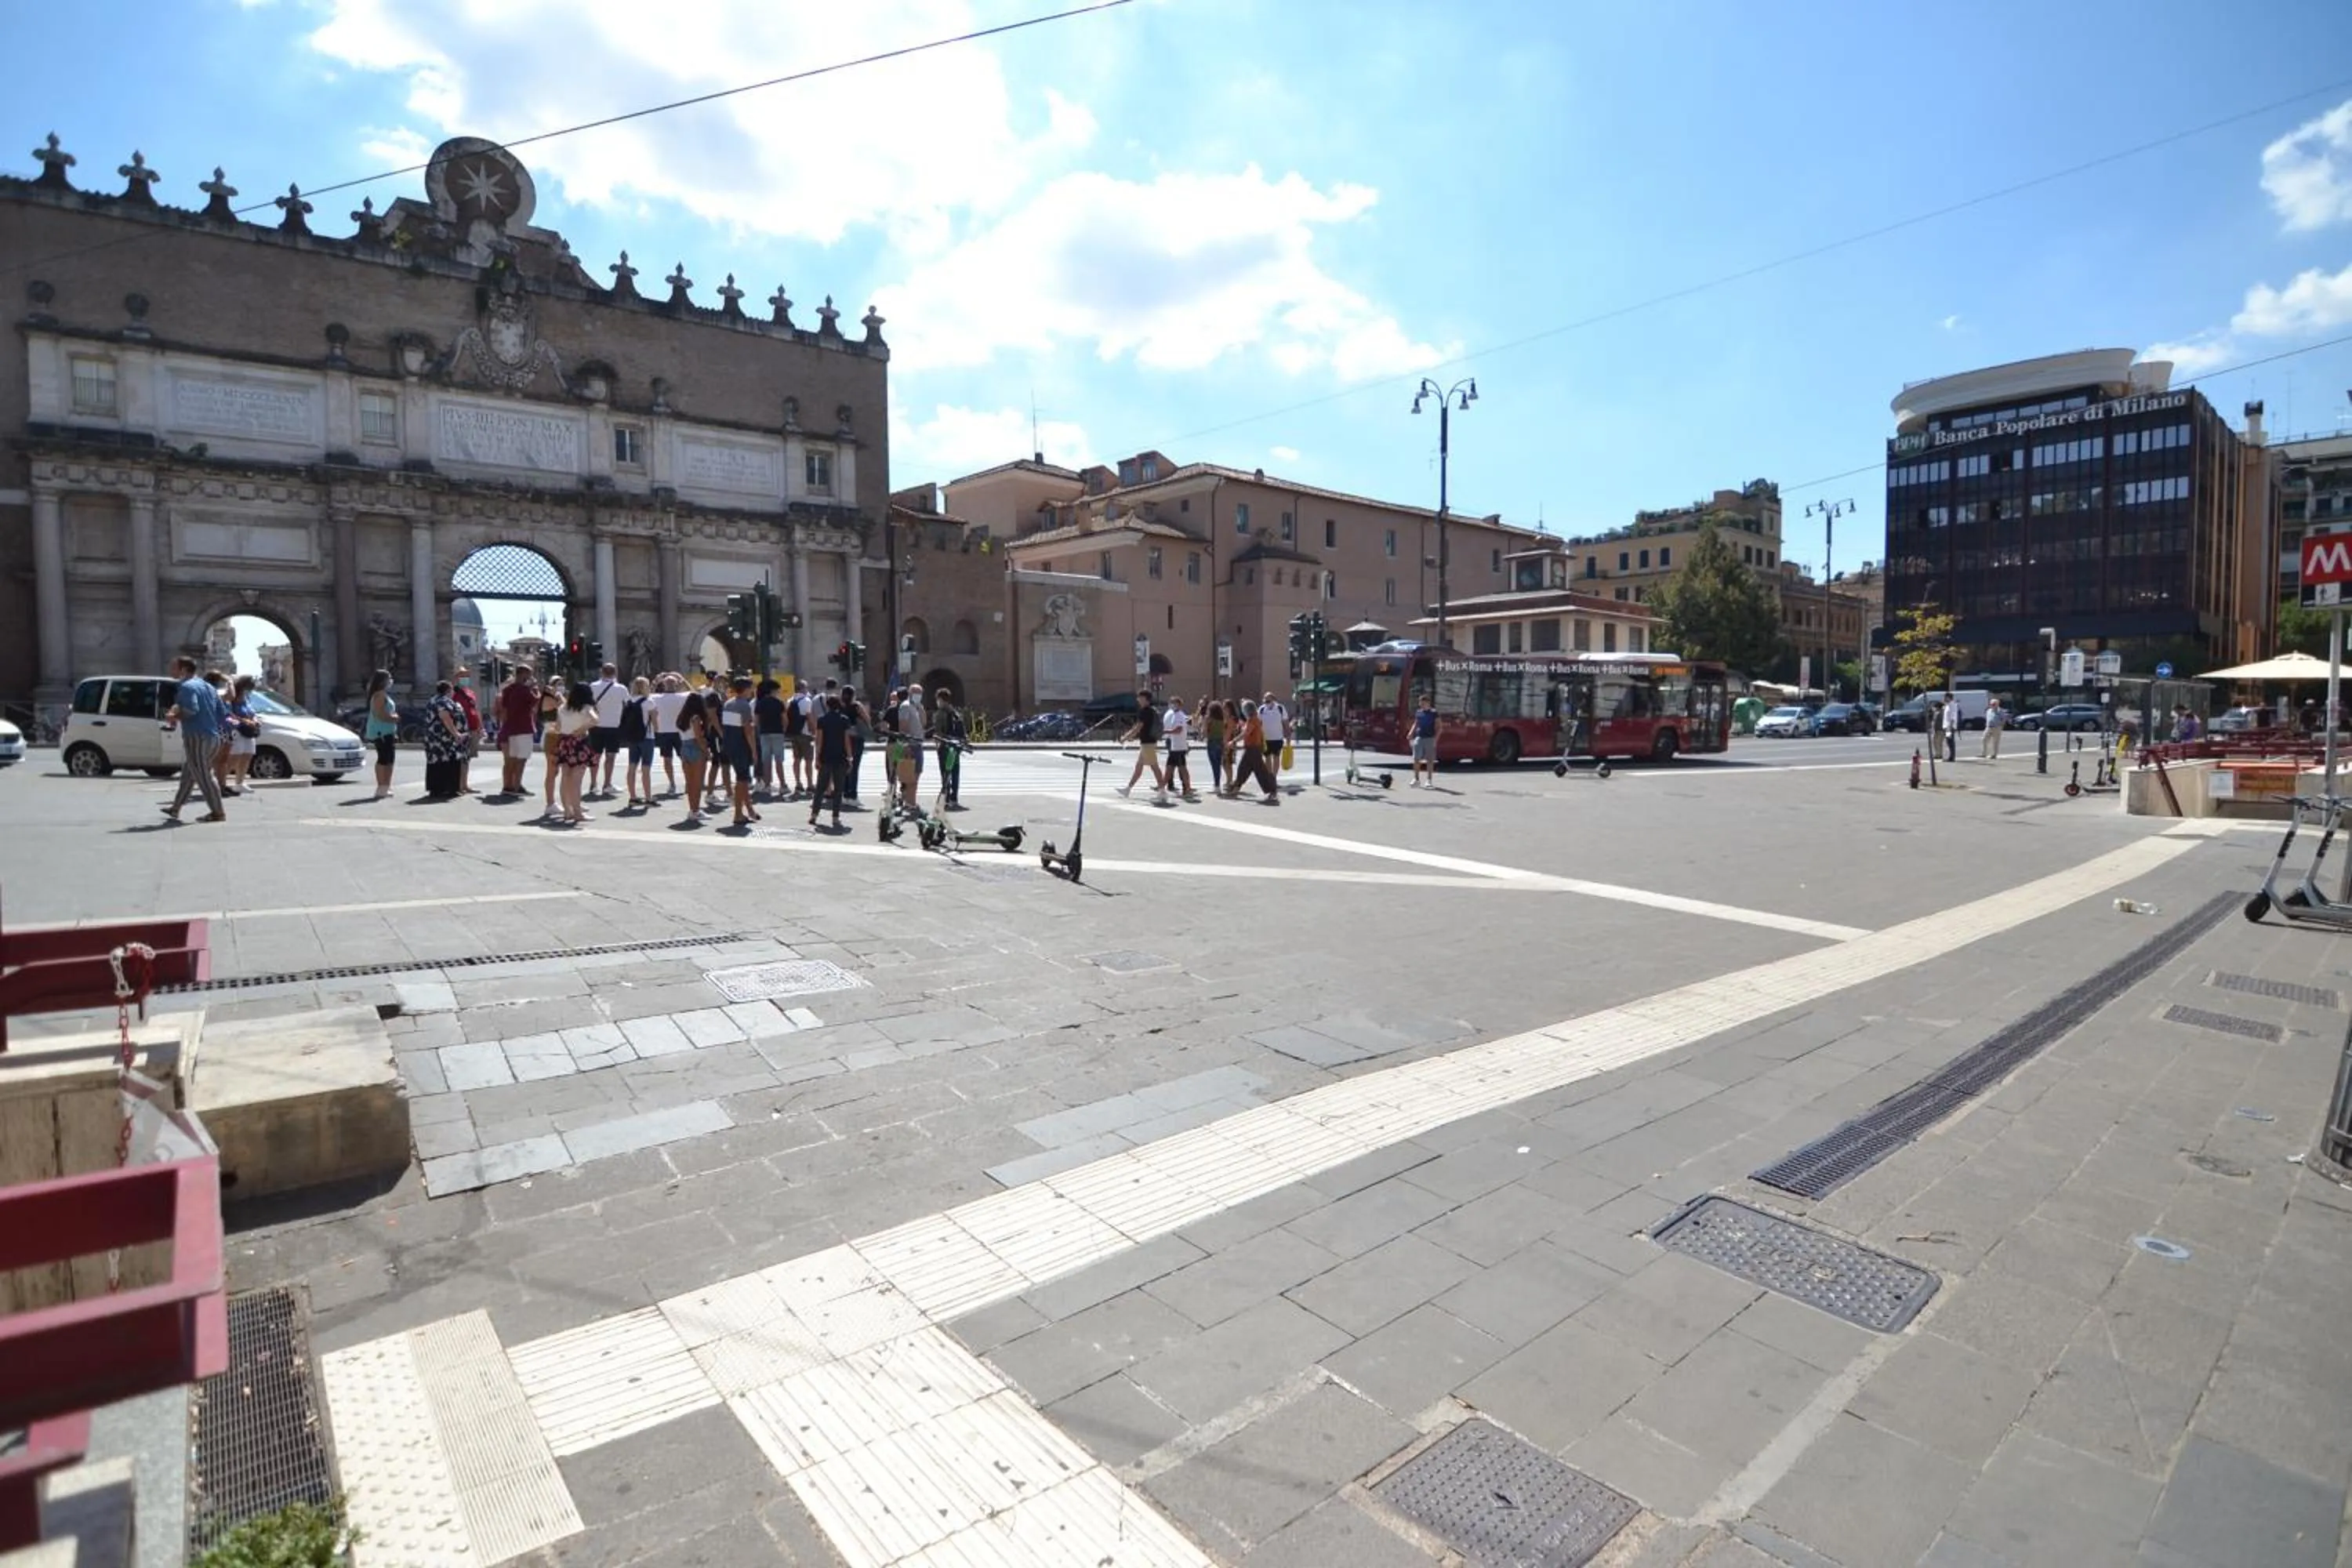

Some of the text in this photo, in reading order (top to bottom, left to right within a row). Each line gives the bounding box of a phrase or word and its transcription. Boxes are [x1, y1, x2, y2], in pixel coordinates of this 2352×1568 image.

[1934, 426, 1989, 446] Banca
[1996, 412, 2078, 436] Popolare
[2084, 404, 2105, 421] di
[2111, 394, 2187, 417] Milano
[2305, 542, 2351, 576] M
